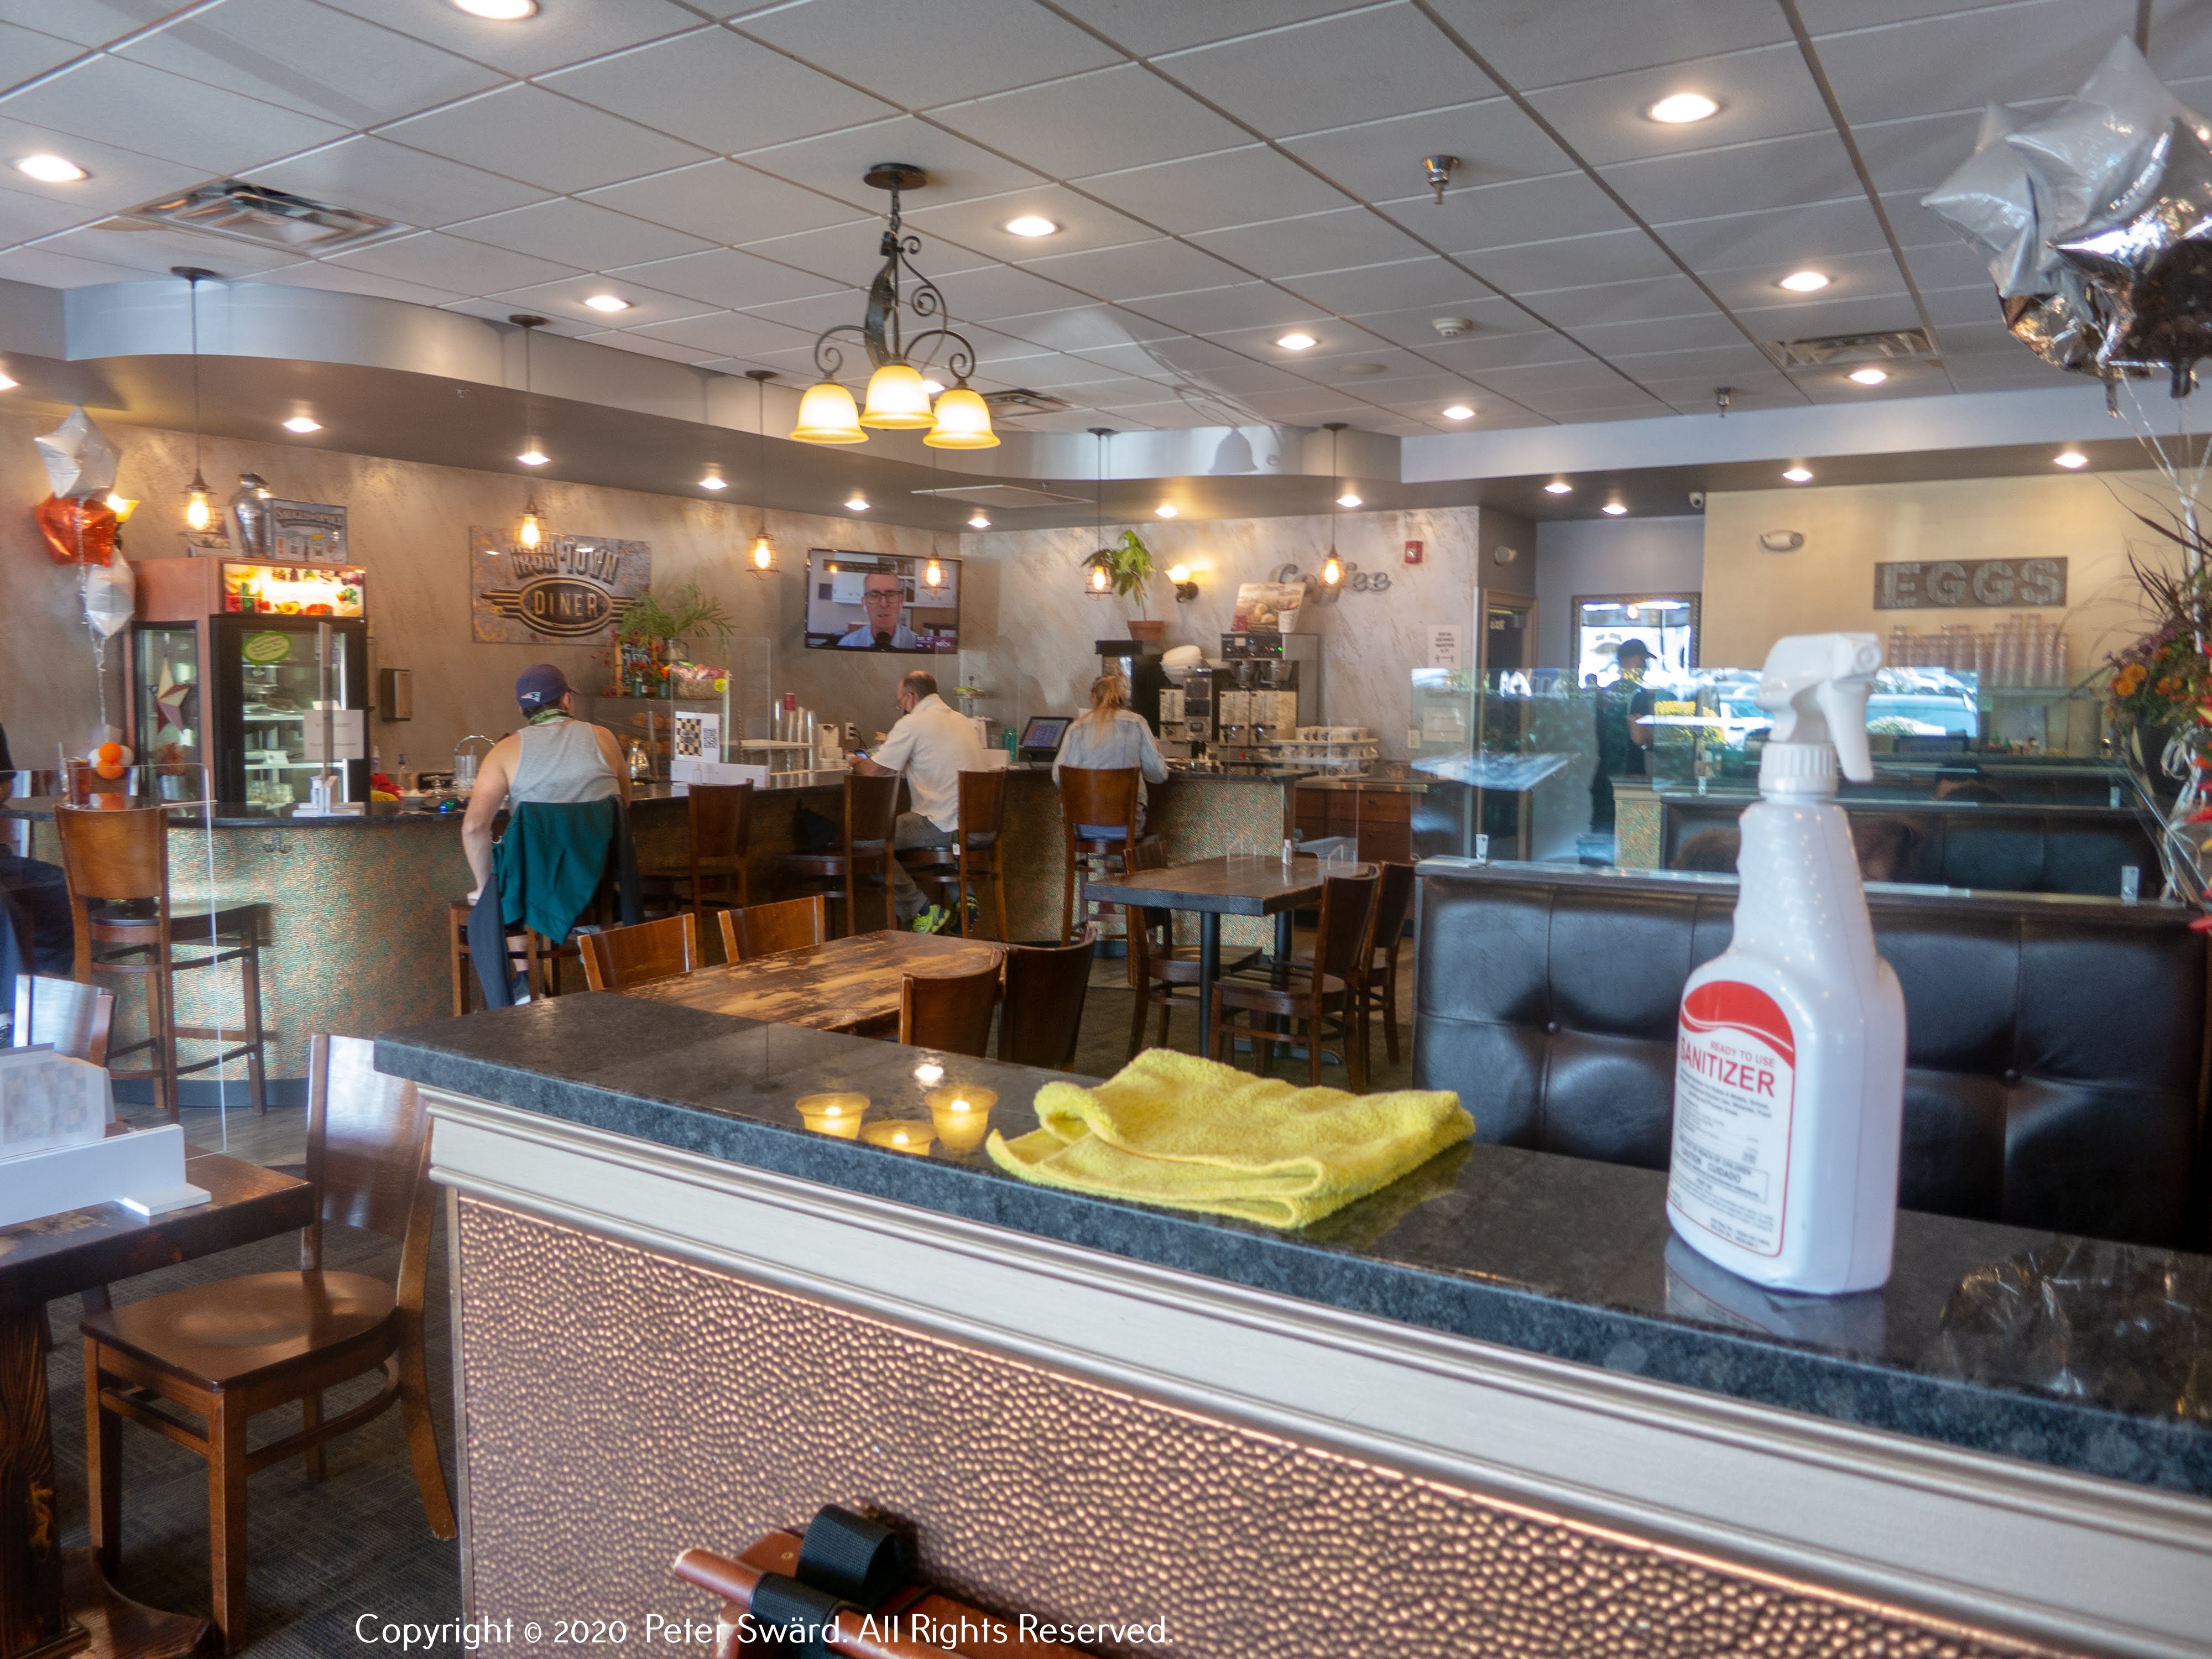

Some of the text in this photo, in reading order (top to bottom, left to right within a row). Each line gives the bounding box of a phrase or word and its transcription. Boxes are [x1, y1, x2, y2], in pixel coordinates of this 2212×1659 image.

[1884, 559, 2062, 607] EGGS
[534, 589, 598, 618] DINER
[1681, 1036, 1775, 1098] SANITIZER
[1710, 1040, 1775, 1068] READY TO USE
